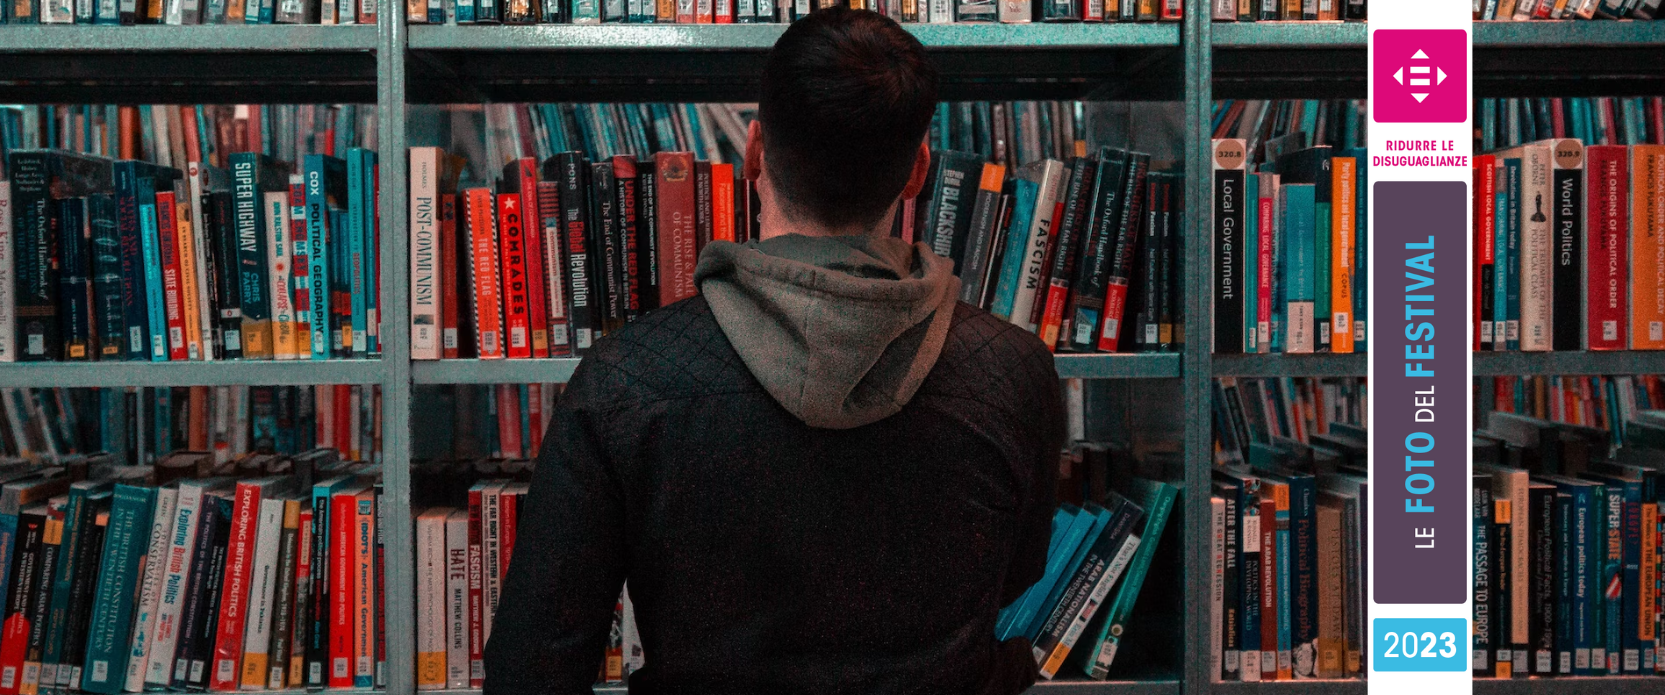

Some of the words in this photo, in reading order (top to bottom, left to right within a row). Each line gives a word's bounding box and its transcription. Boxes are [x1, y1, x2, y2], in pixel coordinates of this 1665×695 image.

[1556, 150, 1580, 158] 320.9
[235, 163, 253, 198] SUPER
[310, 171, 319, 195] COX
[568, 163, 576, 189] PONS
[1075, 165, 1083, 178] THE
[1341, 162, 1349, 179] Party
[1071, 180, 1080, 198] RISE
[1105, 192, 1114, 206] The
[1223, 180, 1234, 212] Local
[1341, 180, 1349, 202] politics
[1563, 179, 1572, 215] World
[567, 209, 578, 220] The
[602, 201, 611, 216] The
[625, 181, 635, 226] UNDER
[979, 193, 992, 229] MODERNISM
[1068, 200, 1076, 211] OF
[1341, 205, 1349, 213] and
[238, 201, 256, 252] HIGHWAY
[603, 219, 612, 235] End
[620, 218, 625, 227] OF
[673, 212, 681, 225] OF
[684, 215, 692, 234] THE
[934, 187, 959, 257] BLACKSHIR
[1065, 213, 1073, 227] THE
[1100, 209, 1112, 234] Oxford
[1262, 202, 1270, 232] COMPARING
[1341, 215, 1349, 229] local
[1610, 219, 1616, 231] OF
[311, 204, 321, 260] POLITICAL
[568, 221, 585, 252] Global
[605, 237, 613, 246] of
[627, 227, 636, 249] THE
[976, 230, 985, 244] AND
[1062, 230, 1070, 244] FAR
[1563, 221, 1572, 265] Politics
[417, 197, 431, 304] POST-COMMUNISM
[478, 238, 488, 253] THE
[972, 246, 982, 269] FASCISM
[1026, 219, 1050, 289] FASCISM
[1057, 246, 1067, 269] RIGHT
[1094, 237, 1107, 275] Handbook
[1223, 218, 1234, 299] Government
[1341, 231, 1349, 267] government
[480, 257, 489, 271] RED
[507, 214, 524, 314] COMRADES
[605, 247, 616, 293] Communist
[628, 253, 637, 276] RED
[674, 229, 682, 297] COMMUNISM
[164, 269, 176, 288] STATE
[243, 272, 251, 304] PARRY
[252, 273, 260, 302] CHRIS
[481, 276, 491, 295] FLAG
[571, 254, 587, 307] Revolution
[685, 272, 693, 294] FALL
[1092, 278, 1100, 288] of
[166, 291, 178, 320] BUILDING
[313, 266, 323, 333] GEOGRAPHY
[609, 295, 617, 318] Power
[629, 279, 638, 309] FLAG
[116, 508, 124, 518] IN
[123, 510, 134, 530] THE
[237, 489, 251, 540] EXPLORING
[1227, 499, 1235, 525] AFTER
[1577, 507, 1586, 543] European
[113, 522, 122, 539] THE
[174, 509, 191, 545] Exploring
[1227, 529, 1235, 544] THE
[1477, 525, 1485, 538] THE
[117, 532, 131, 572] BRITISH
[1120, 542, 1135, 561] That's
[1298, 519, 1309, 571] Political
[40, 547, 53, 589] COMPARING
[141, 523, 162, 606] CONSERVATISM
[170, 547, 184, 572] British
[233, 542, 245, 576] BRITISH
[451, 549, 464, 580] HATE
[470, 545, 480, 589] FASCISM
[1088, 559, 1104, 581] ARAB
[1111, 563, 1123, 574] Not
[1227, 549, 1235, 568] FALL
[1475, 542, 1487, 587] PASSAGE
[1577, 546, 1586, 573] politics
[103, 544, 118, 600] TWENTIETH
[165, 575, 179, 604] Politics
[228, 578, 241, 617] POLITICS
[1095, 575, 1114, 599] English
[1476, 590, 1487, 602] TO
[1577, 575, 1586, 597] today
[37, 591, 47, 612] ASIAN
[104, 575, 124, 653] CONSTITUTION
[1052, 583, 1090, 637] NATIONALISM
[1297, 574, 1310, 639] Biography
[32, 614, 44, 645] POLITICS
[95, 603, 109, 650] CENTURY
[1476, 605, 1488, 644] EUROPE
